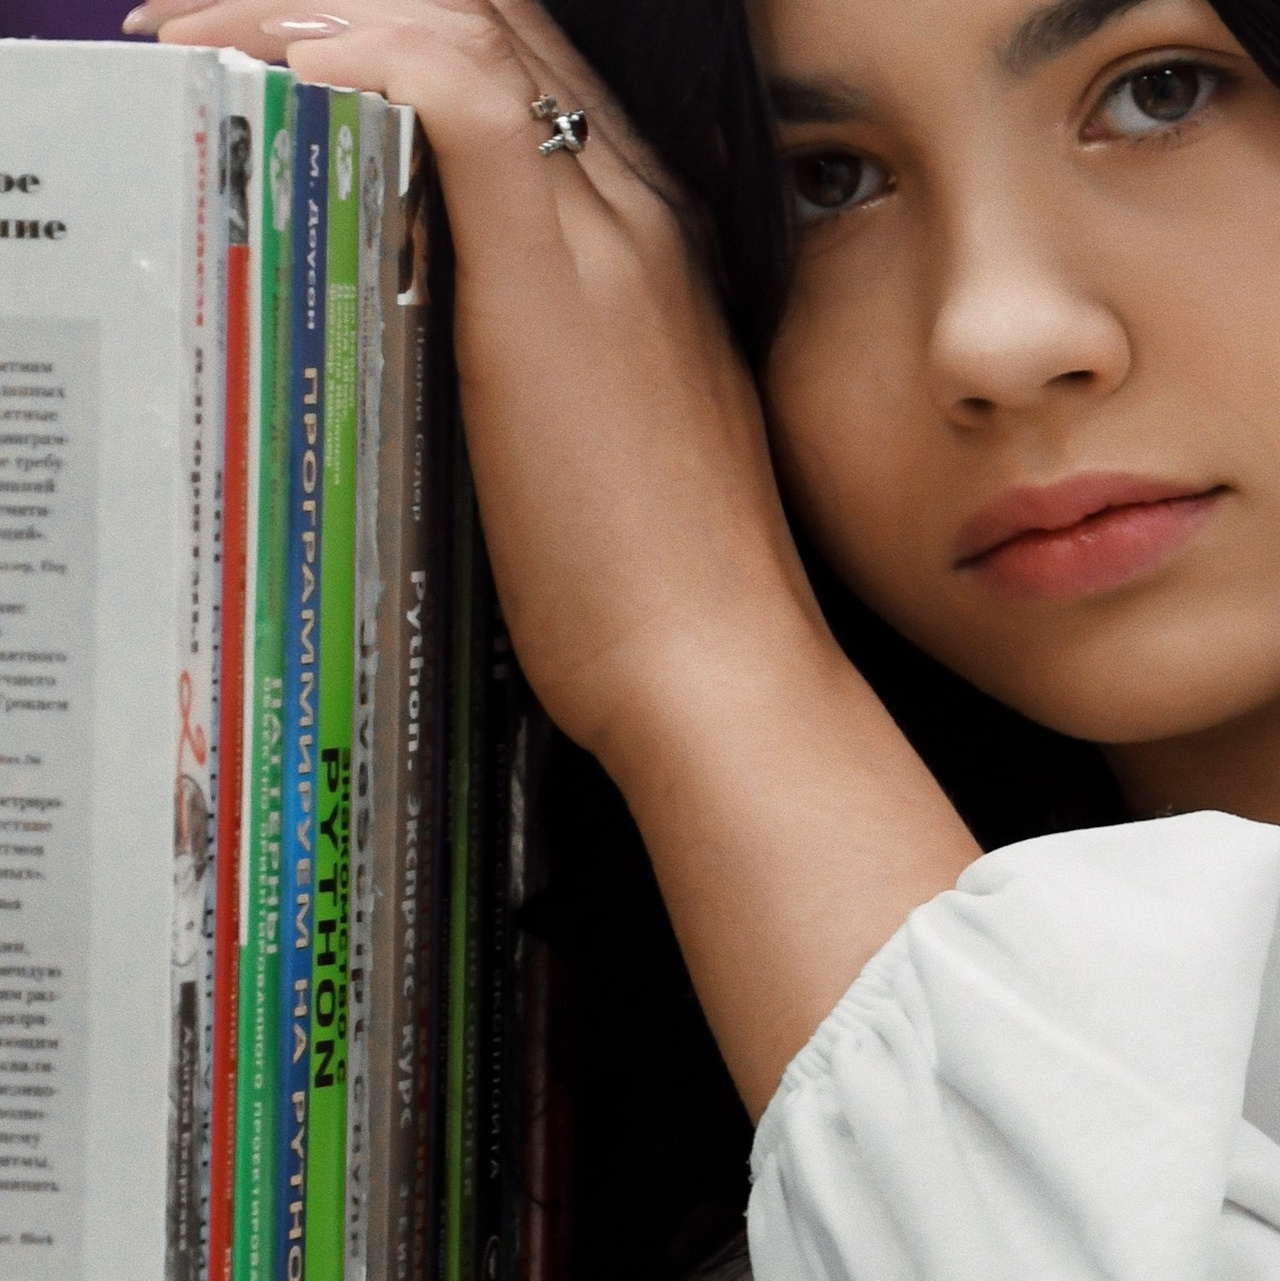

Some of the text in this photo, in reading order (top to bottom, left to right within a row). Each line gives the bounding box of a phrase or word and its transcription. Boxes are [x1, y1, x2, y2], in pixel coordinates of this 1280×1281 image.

[305, 143, 320, 331] М. Доусон
[294, 365, 319, 949] ПРОГРАММИРУЕМ
[406, 569, 426, 771] Python.
[291, 978, 309, 1064] НА
[313, 748, 340, 1089] PYTHON
[397, 792, 421, 1129] Экспресс-курс
